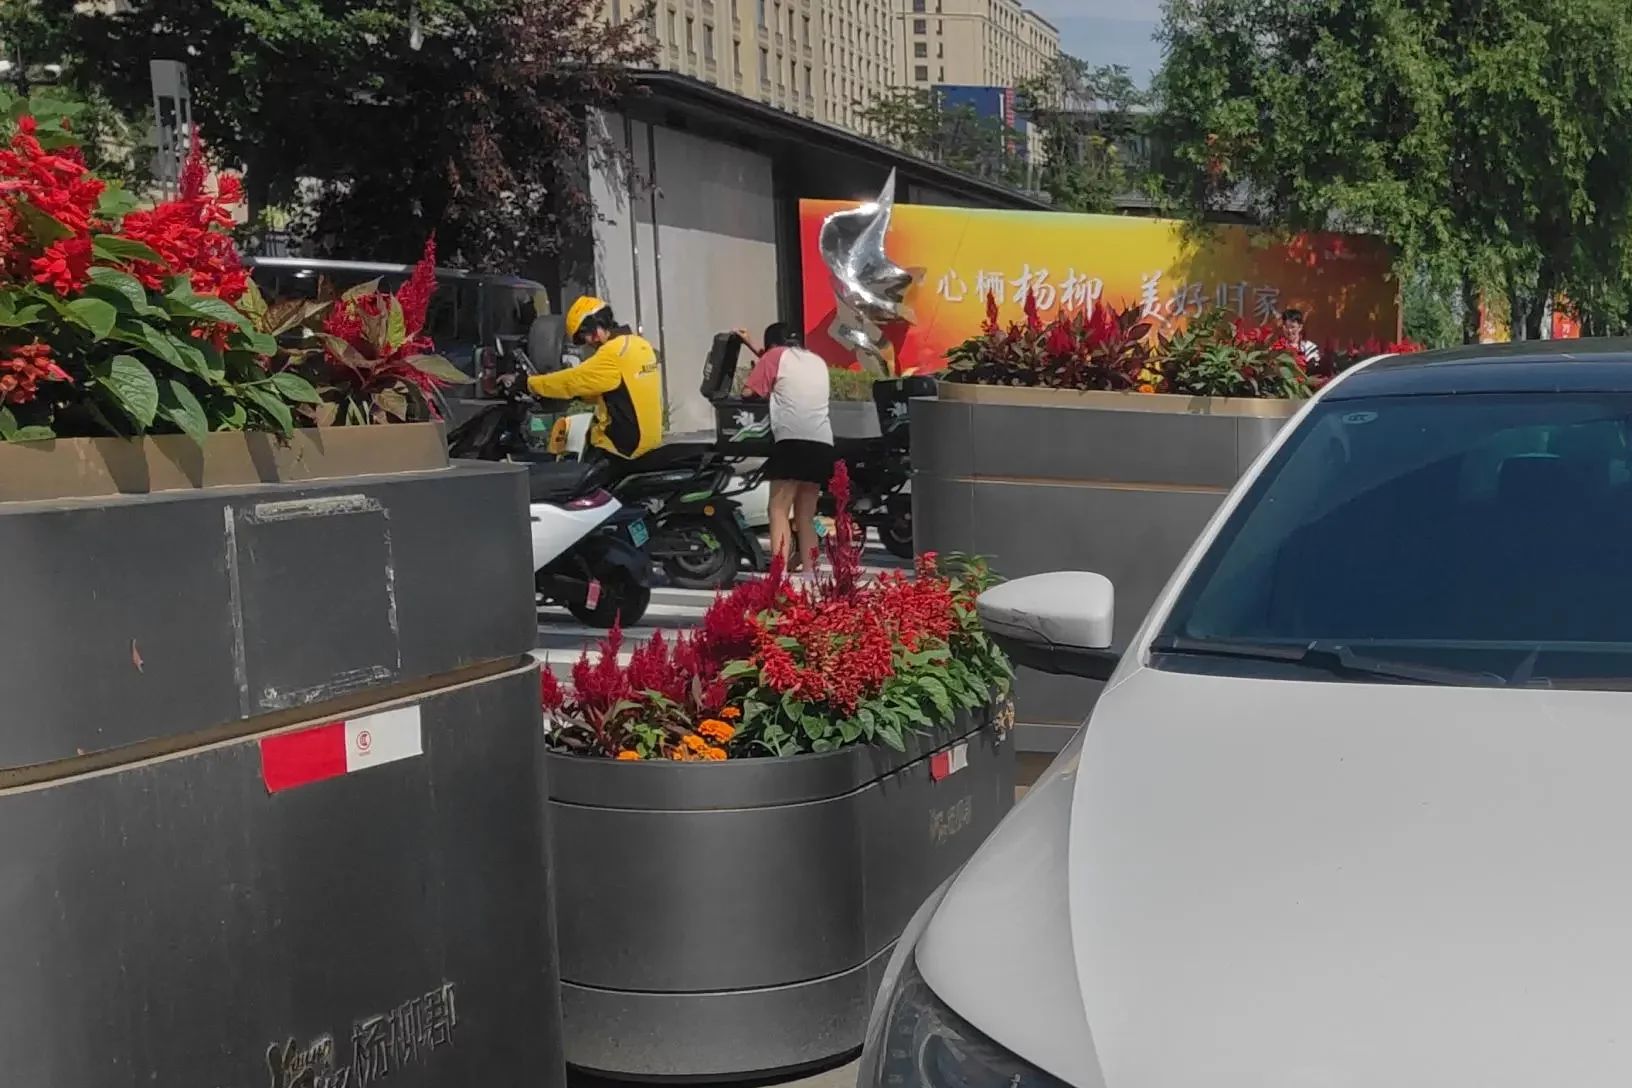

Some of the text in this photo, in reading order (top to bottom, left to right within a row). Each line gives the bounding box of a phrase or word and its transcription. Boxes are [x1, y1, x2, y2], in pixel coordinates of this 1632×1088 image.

[936, 264, 1282, 328] 心栖杨柳 美好归家
